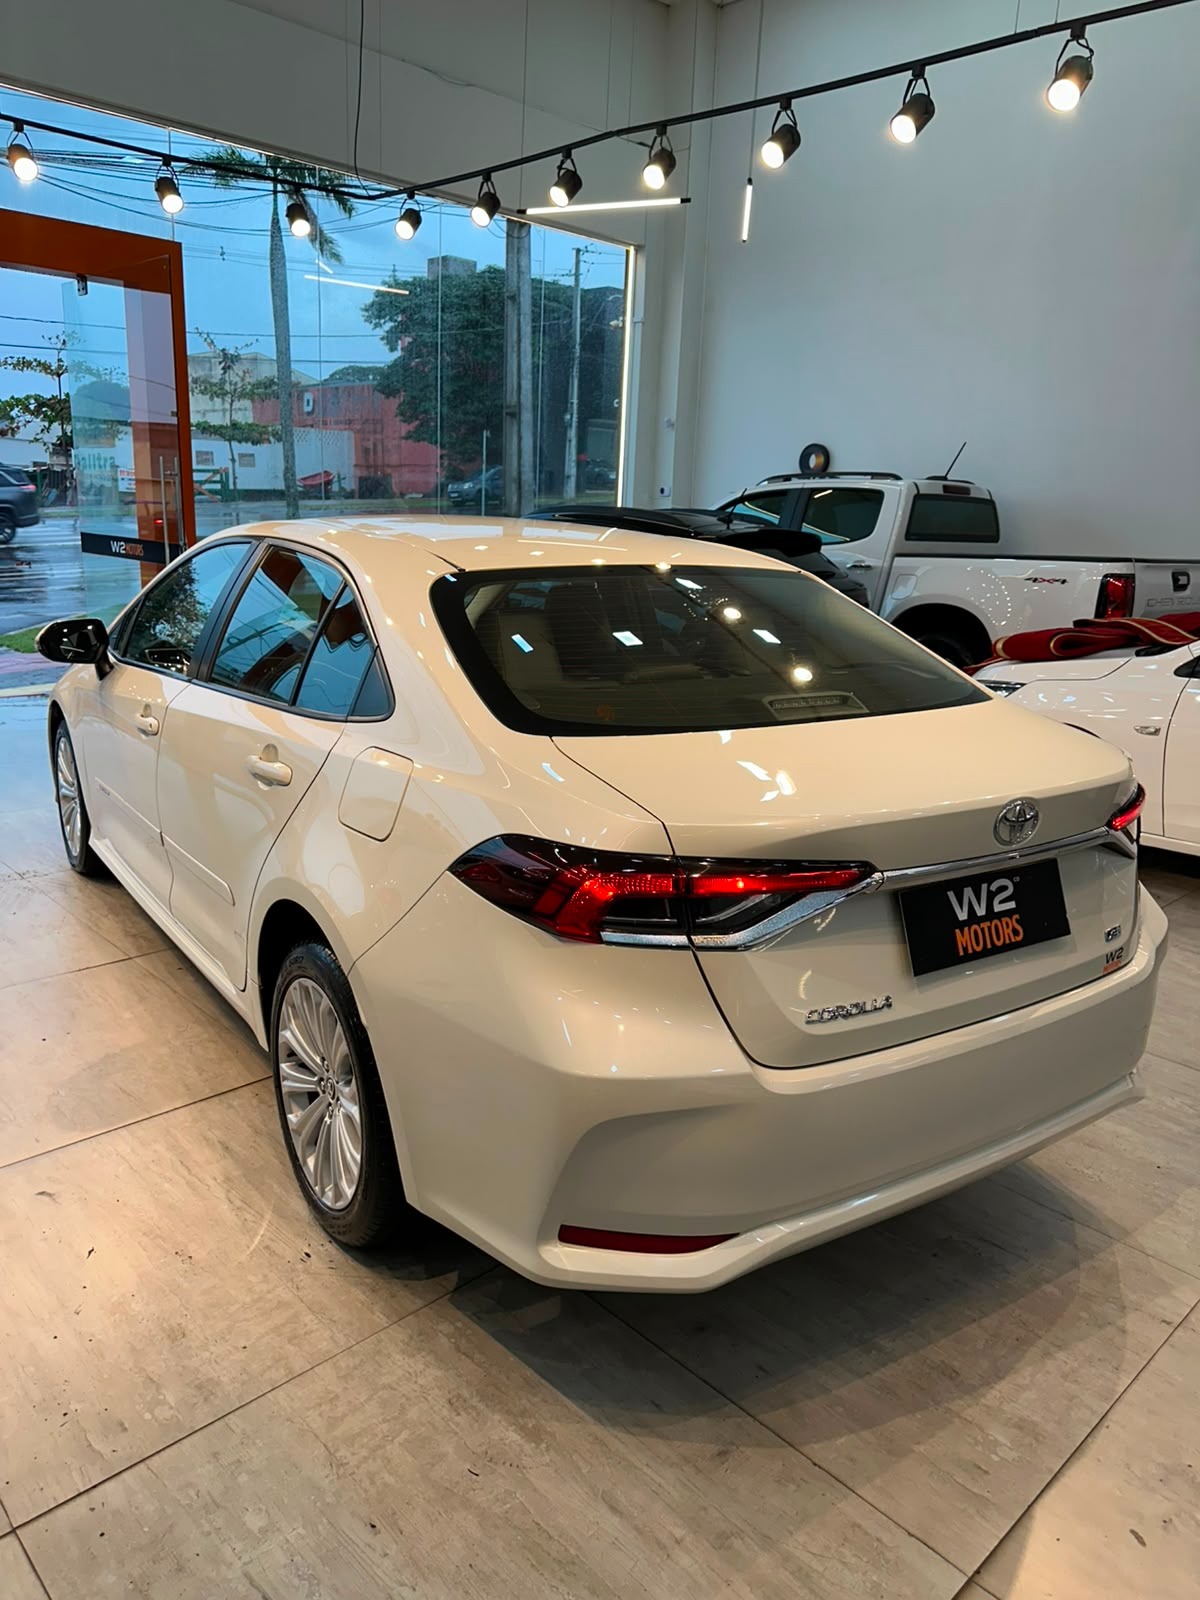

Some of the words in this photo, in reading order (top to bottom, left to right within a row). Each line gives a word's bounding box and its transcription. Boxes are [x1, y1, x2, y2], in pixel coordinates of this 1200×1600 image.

[110, 540, 126, 553] W2
[946, 878, 1016, 921] W2
[955, 914, 1024, 956] MOTORS
[1105, 946, 1124, 964] W2
[805, 995, 893, 1025] COROLLA
